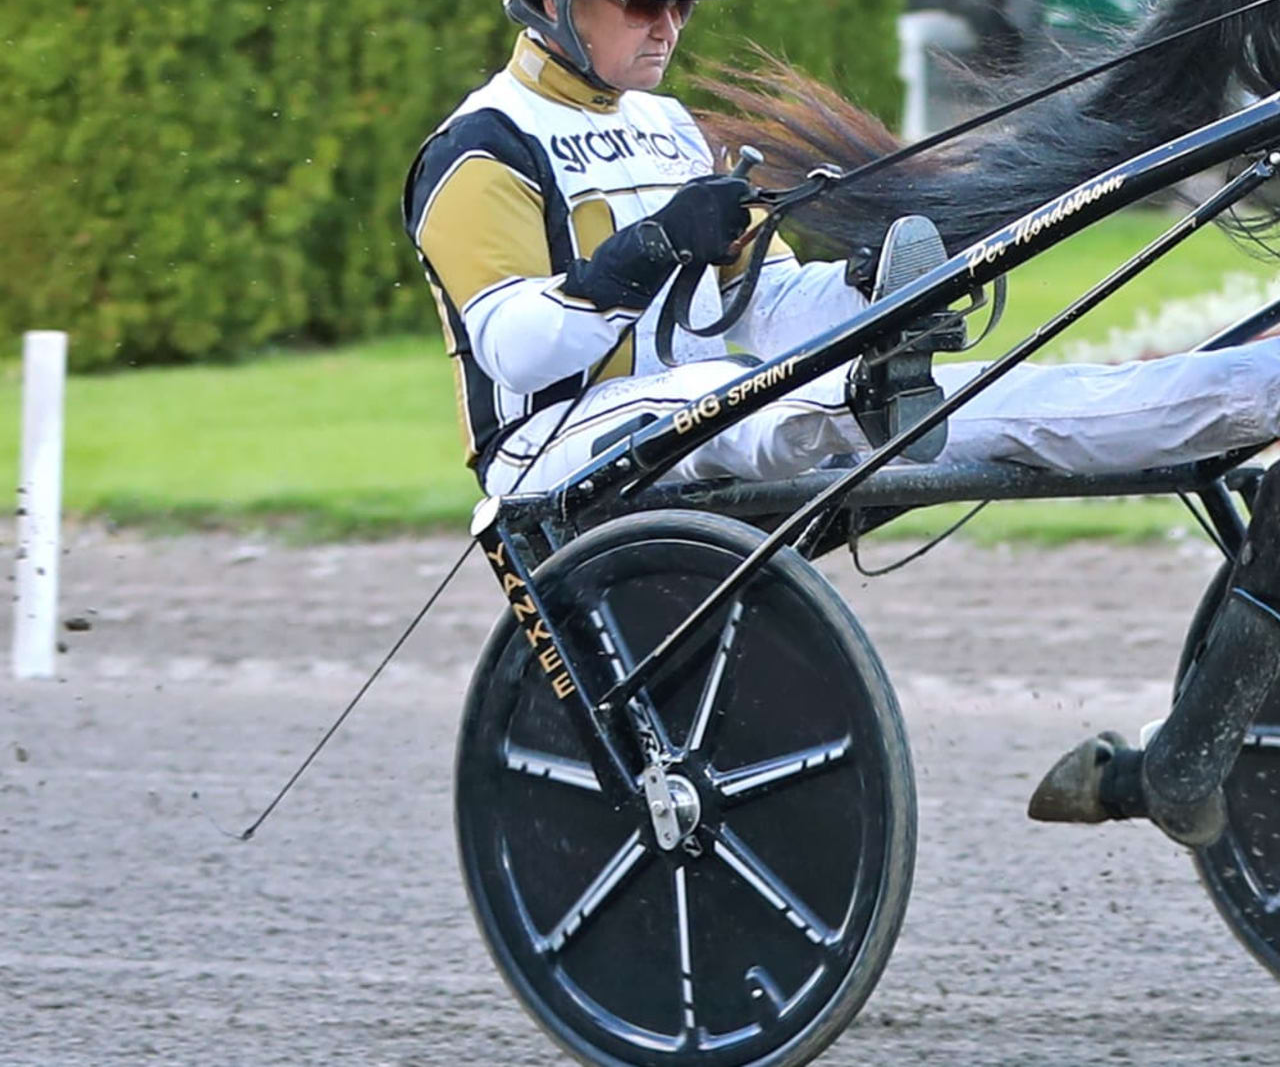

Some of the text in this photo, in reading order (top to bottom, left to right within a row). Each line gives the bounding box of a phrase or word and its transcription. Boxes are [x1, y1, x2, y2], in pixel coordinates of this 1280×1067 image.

[966, 241, 1005, 277] Per
[727, 356, 799, 407] SPRINT
[487, 541, 576, 700] YANKEE
